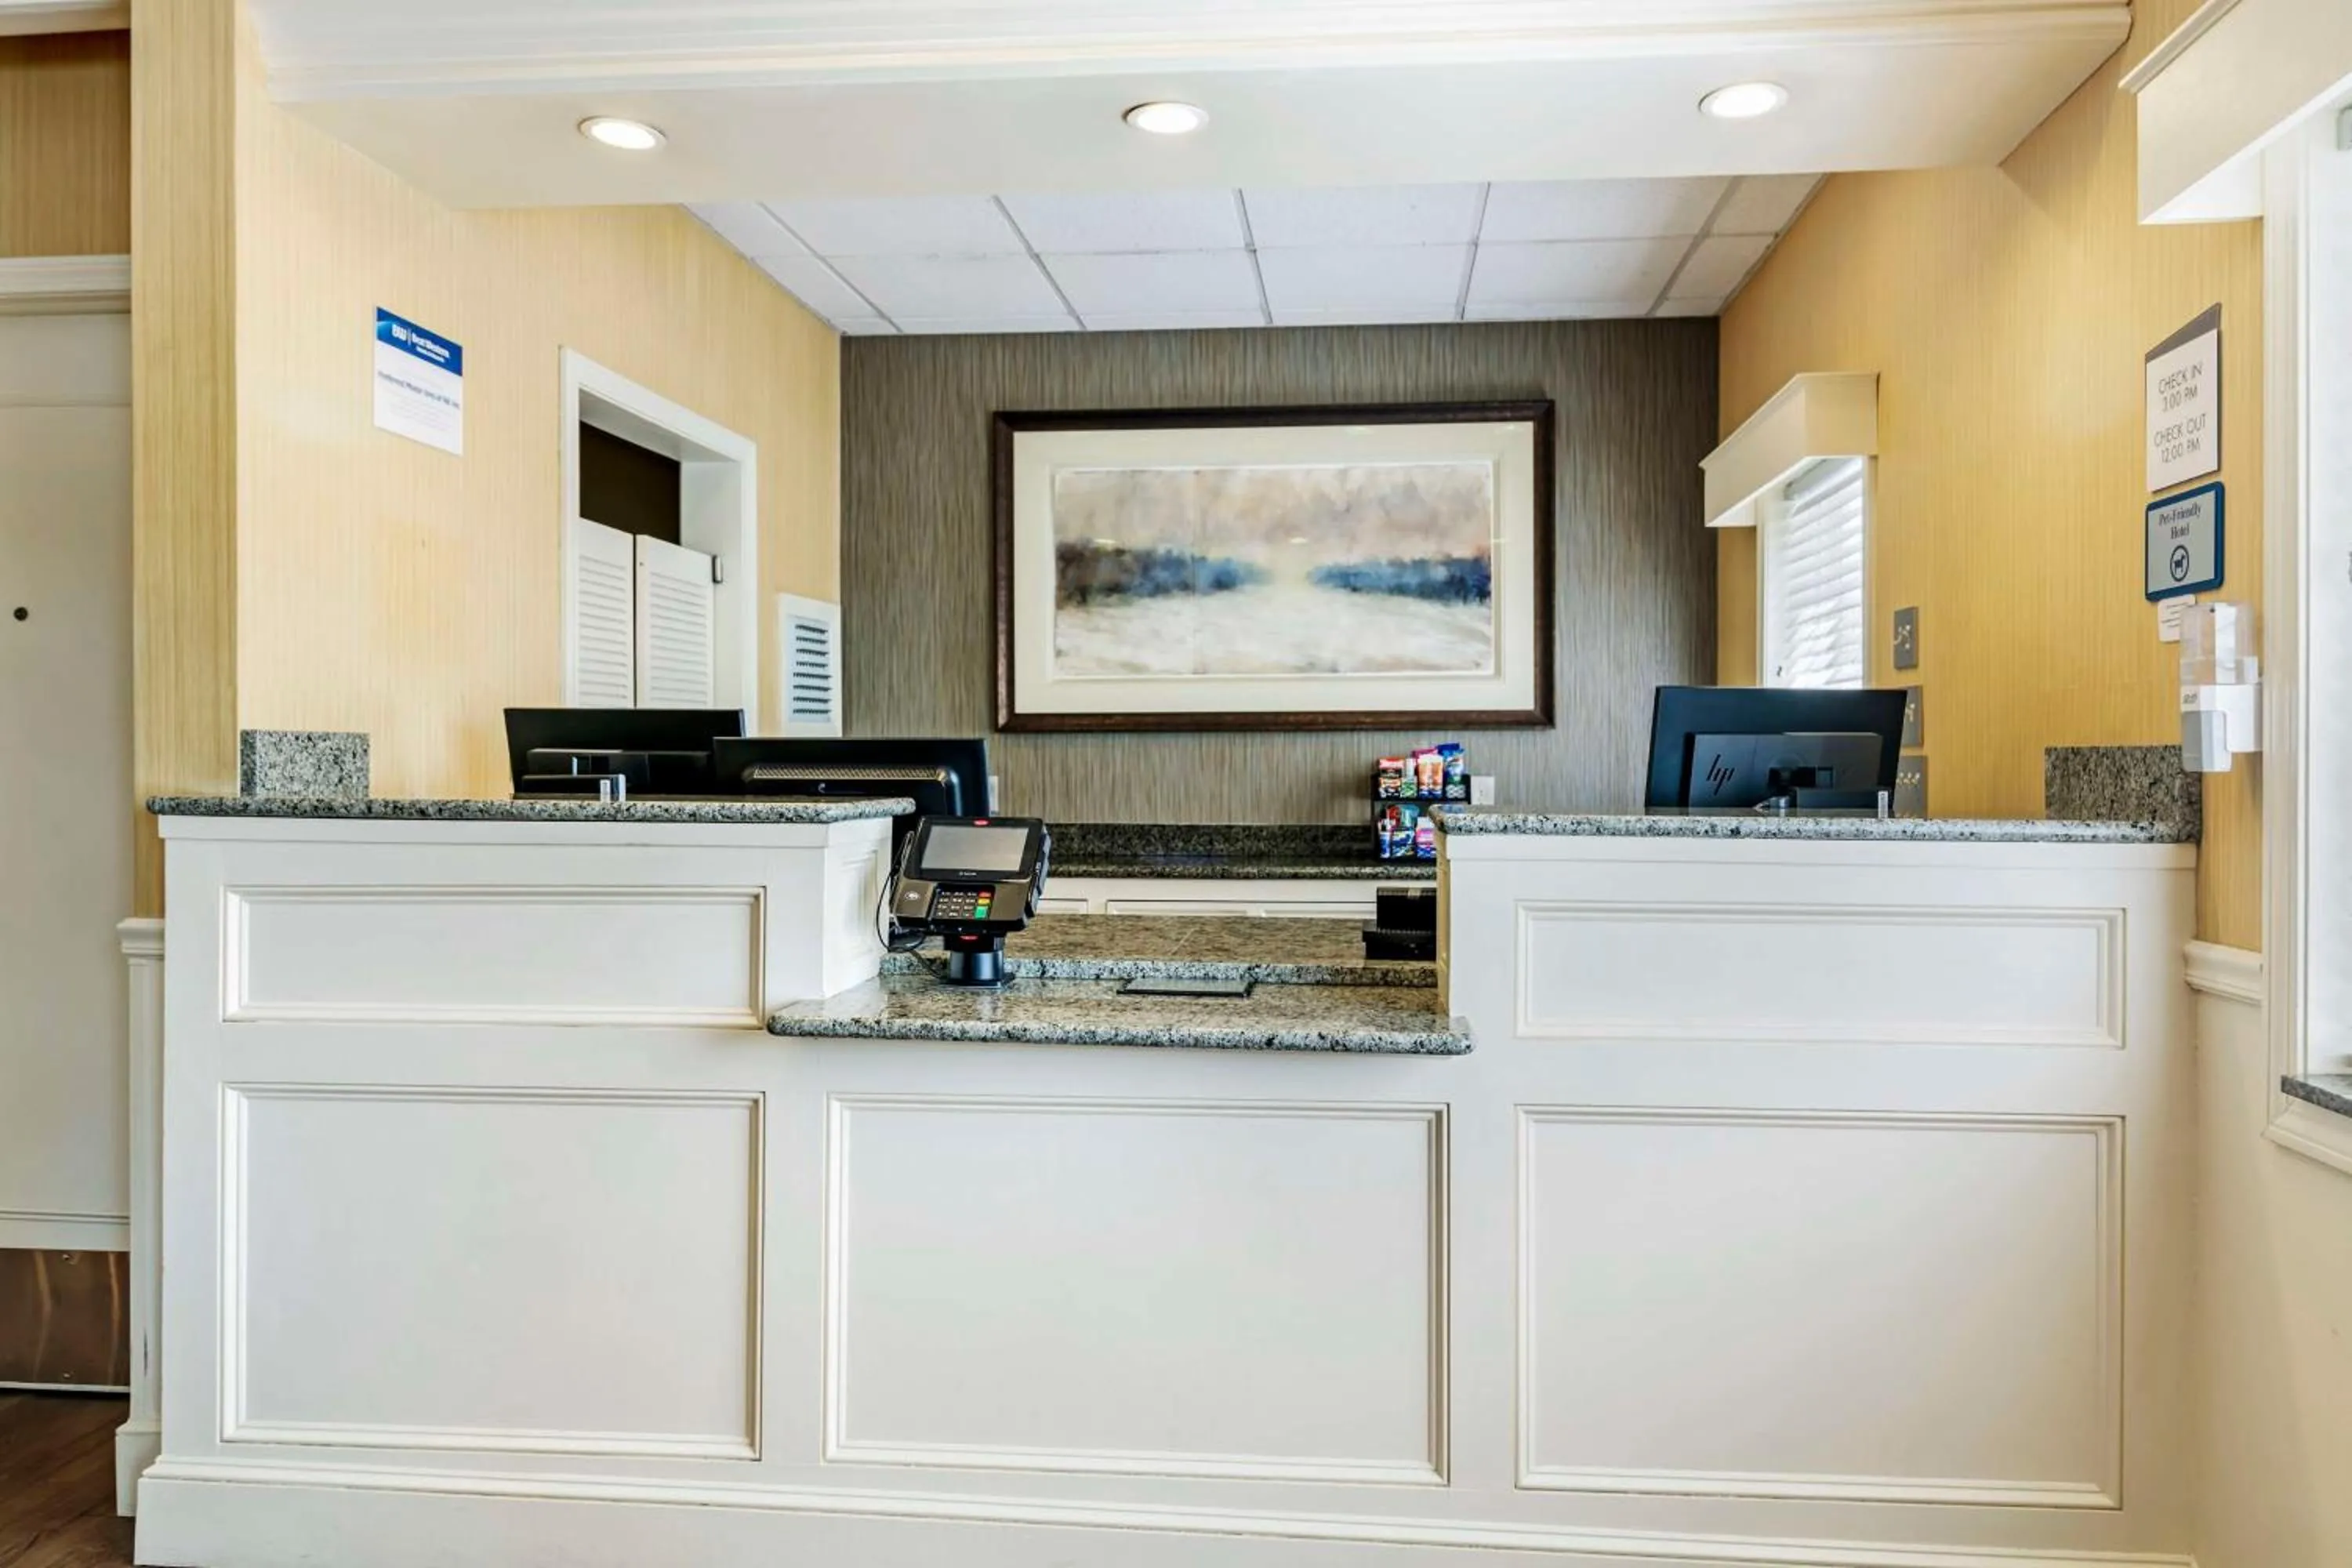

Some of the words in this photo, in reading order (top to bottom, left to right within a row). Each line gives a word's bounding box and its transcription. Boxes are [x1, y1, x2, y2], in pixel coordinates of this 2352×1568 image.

[2158, 365, 2189, 394] CHECK
[2191, 360, 2204, 379] IN
[2184, 383, 2198, 403] PM
[2154, 422, 2184, 448] CHECK
[2187, 412, 2206, 434] OUT
[2187, 437, 2201, 454] PM
[2158, 502, 2201, 527] Pet-Friendly
[2170, 522, 2190, 539] Hotel
[1705, 753, 1735, 796] hp
